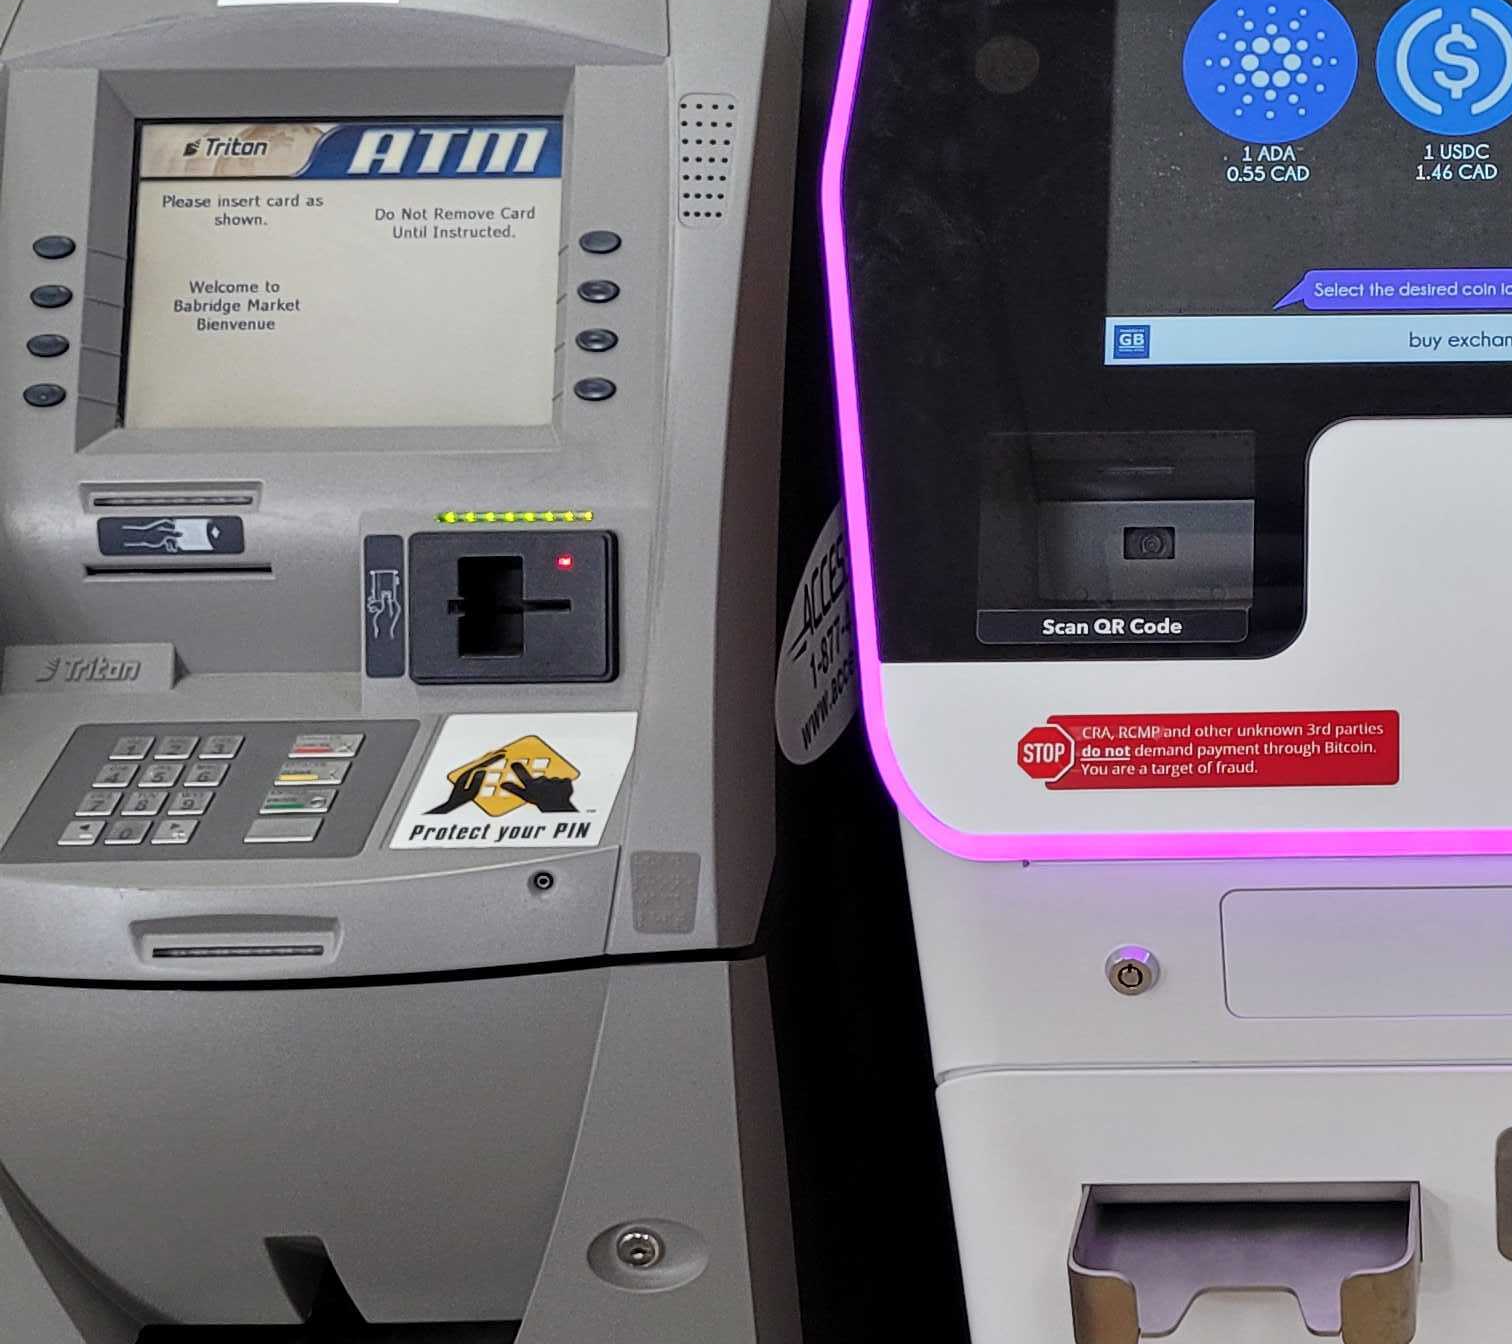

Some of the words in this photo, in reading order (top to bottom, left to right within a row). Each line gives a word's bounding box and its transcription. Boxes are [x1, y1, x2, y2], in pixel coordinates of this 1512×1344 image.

[205, 137, 269, 158] Triton
[346, 127, 549, 174] ATM
[1242, 145, 1252, 162] 1
[1257, 145, 1297, 161] ADA
[1424, 144, 1435, 160] 1
[1439, 143, 1490, 160] USDC
[1226, 166, 1267, 182] 0.55
[1270, 165, 1310, 182] CAD
[1415, 163, 1453, 181] 1.46
[1458, 163, 1498, 180] CAD
[162, 194, 212, 209] Please
[217, 194, 261, 209] insert
[266, 194, 301, 208] card
[306, 196, 324, 208] as
[214, 213, 269, 227] shown.
[374, 208, 395, 221] Do
[402, 207, 428, 221] Not
[434, 207, 495, 221] Remove
[501, 207, 536, 221] Card
[392, 225, 427, 239] Until
[433, 225, 517, 240] Instructed.
[189, 280, 259, 295] Welcome
[264, 281, 280, 294] to
[1313, 281, 1365, 297] Select
[1368, 281, 1395, 297] the
[1398, 281, 1459, 297] desired
[1461, 281, 1497, 297] coin
[173, 299, 242, 315] Babridge
[247, 298, 302, 313] Market
[197, 317, 276, 332] Bienvenue
[1119, 333, 1145, 346] GB
[1408, 331, 1443, 351] buy
[1042, 618, 1089, 635] Scan
[1093, 618, 1125, 635] QR
[1129, 617, 1183, 634] Code
[65, 655, 142, 683] Triton
[1082, 726, 1115, 741] CRA,
[1119, 725, 1161, 740] RCMP
[1163, 725, 1191, 738] and
[1194, 724, 1232, 738] other
[1237, 723, 1303, 737] unknown
[1306, 723, 1331, 736] 3rd
[1335, 722, 1384, 739] parties
[1023, 742, 1066, 764] STOP
[1081, 745, 1100, 758] do
[1104, 745, 1131, 758] not
[1135, 743, 1193, 757] demand
[1197, 743, 1260, 759] payment
[1263, 742, 1321, 757] through
[1325, 741, 1377, 754] Bitcoin.
[1080, 763, 1108, 776] You
[1112, 765, 1136, 776] are
[1139, 765, 1147, 775] a
[1151, 763, 1193, 777] target
[1197, 761, 1212, 775] of
[1215, 760, 1258, 774] fraud.
[408, 822, 490, 841] Protect
[494, 824, 546, 844] your
[552, 821, 592, 839] PIN
